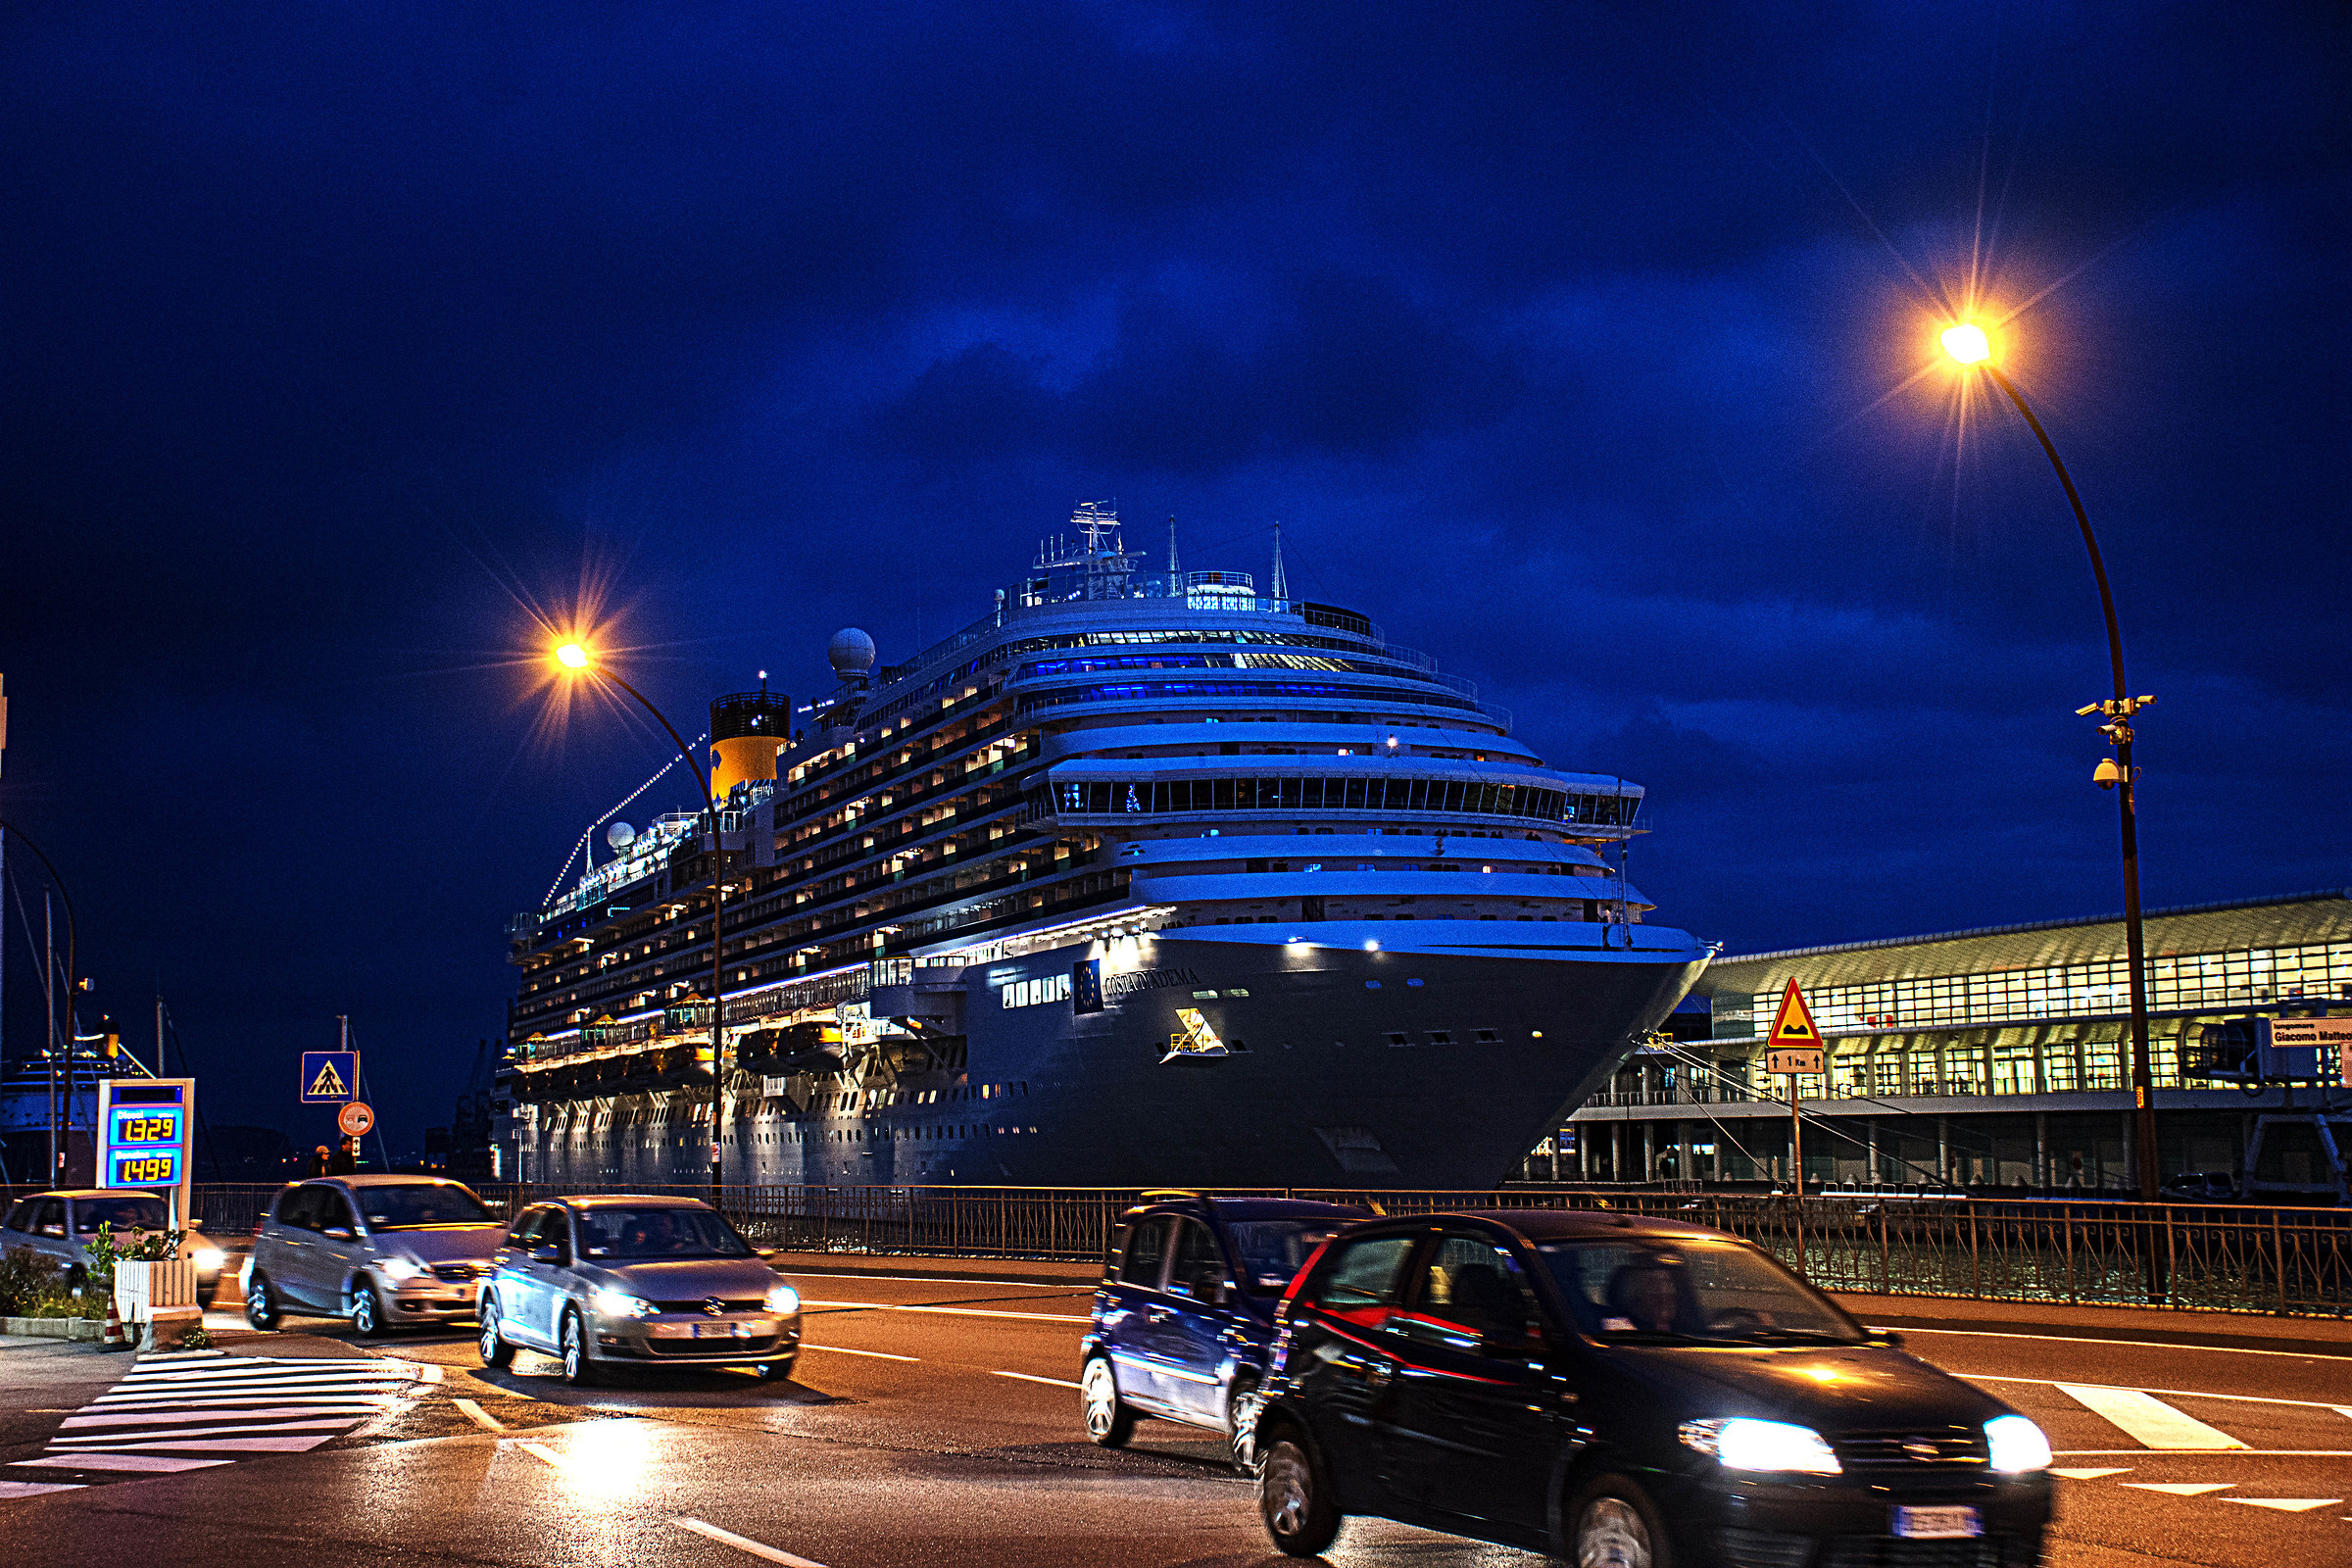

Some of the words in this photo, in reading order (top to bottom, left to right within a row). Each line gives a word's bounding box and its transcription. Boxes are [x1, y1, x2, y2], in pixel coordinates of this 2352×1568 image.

[1104, 973, 1138, 996] COSTA
[1137, 968, 1201, 990] DIADEMA
[2275, 1031, 2317, 1042] Giacomo
